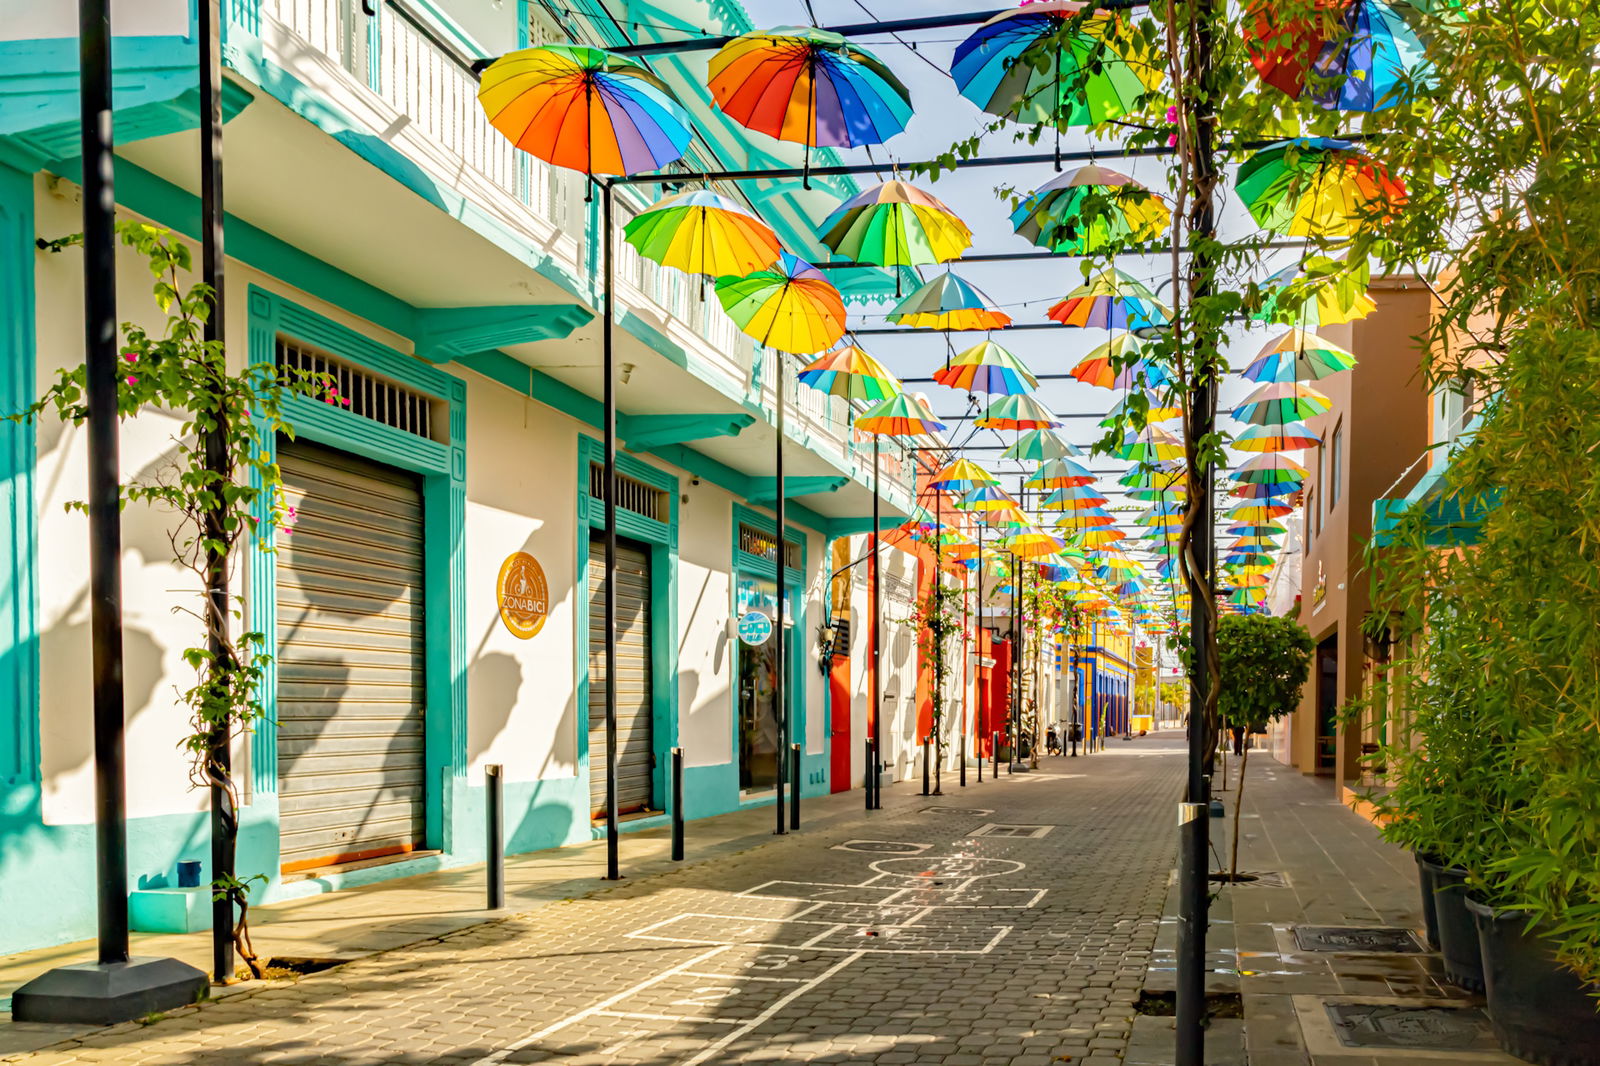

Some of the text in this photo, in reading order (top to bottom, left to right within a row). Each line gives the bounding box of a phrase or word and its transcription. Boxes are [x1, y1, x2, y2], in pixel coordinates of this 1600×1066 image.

[502, 595, 545, 613] ZONABICI
[744, 953, 799, 970] 3
[671, 987, 741, 1007] 2
